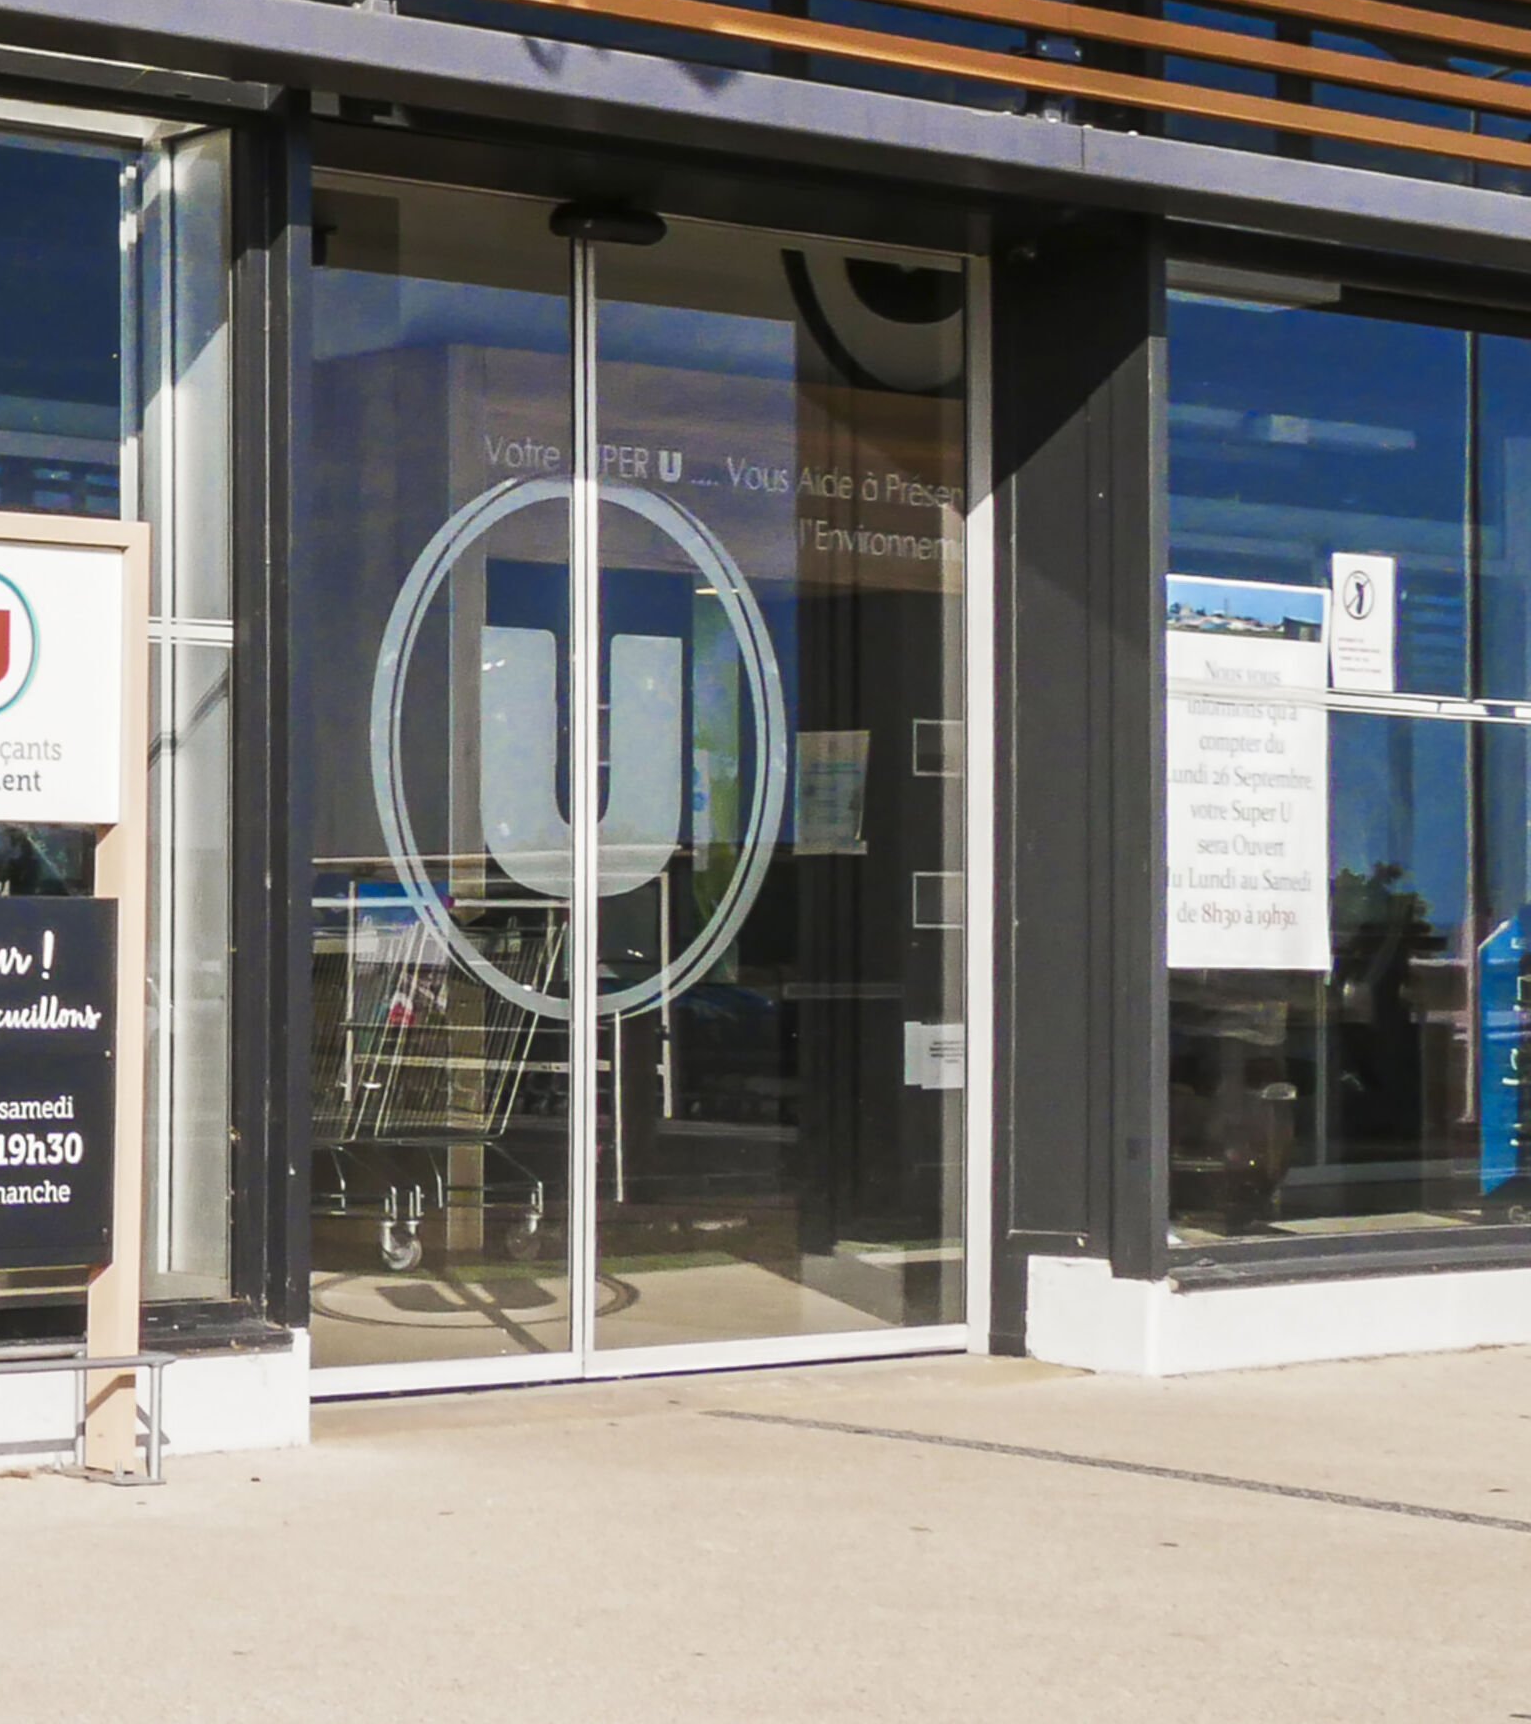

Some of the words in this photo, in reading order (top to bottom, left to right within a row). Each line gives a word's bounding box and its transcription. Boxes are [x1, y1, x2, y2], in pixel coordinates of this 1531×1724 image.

[485, 434, 560, 470] Votre
[658, 450, 683, 483] U
[726, 456, 790, 493] Vous
[798, 466, 853, 500] Aide
[861, 472, 879, 503] à
[1205, 660, 1242, 683] Nous
[1247, 667, 1282, 686] vous
[1199, 735, 1260, 758] compter
[1264, 733, 1284, 754] du
[479, 626, 682, 897] U
[1213, 766, 1229, 786] 26
[1190, 802, 1227, 821] votre
[1231, 800, 1276, 827] Super
[1280, 802, 1292, 823] U
[1197, 838, 1228, 856] sera
[1233, 834, 1285, 857] Ouvert
[1188, 867, 1235, 890] Lundi
[1240, 874, 1258, 891] au
[1262, 870, 1311, 893] Samedi
[1176, 902, 1197, 923] de
[1201, 903, 1241, 930] 8h30
[1245, 905, 1254, 925] à
[41, 930, 55, 979] !
